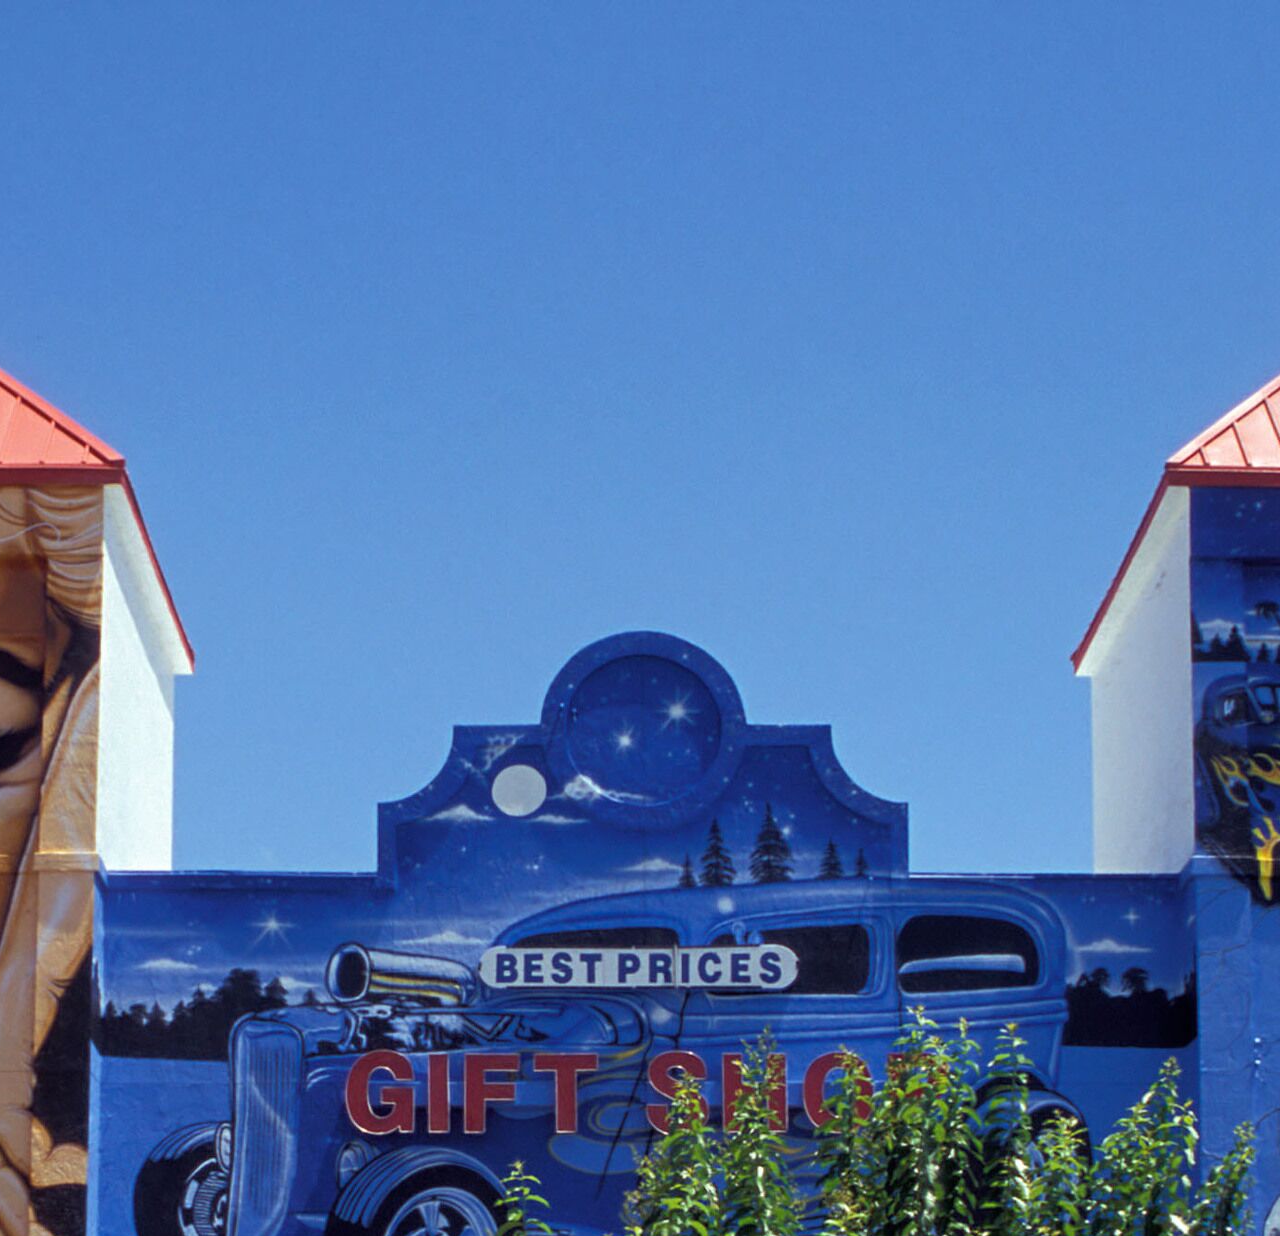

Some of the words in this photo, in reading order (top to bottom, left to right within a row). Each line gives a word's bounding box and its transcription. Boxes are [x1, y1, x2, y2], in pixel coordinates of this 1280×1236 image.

[494, 952, 603, 984] BEST
[617, 951, 782, 985] PRICES
[345, 1049, 599, 1135] GIFT
